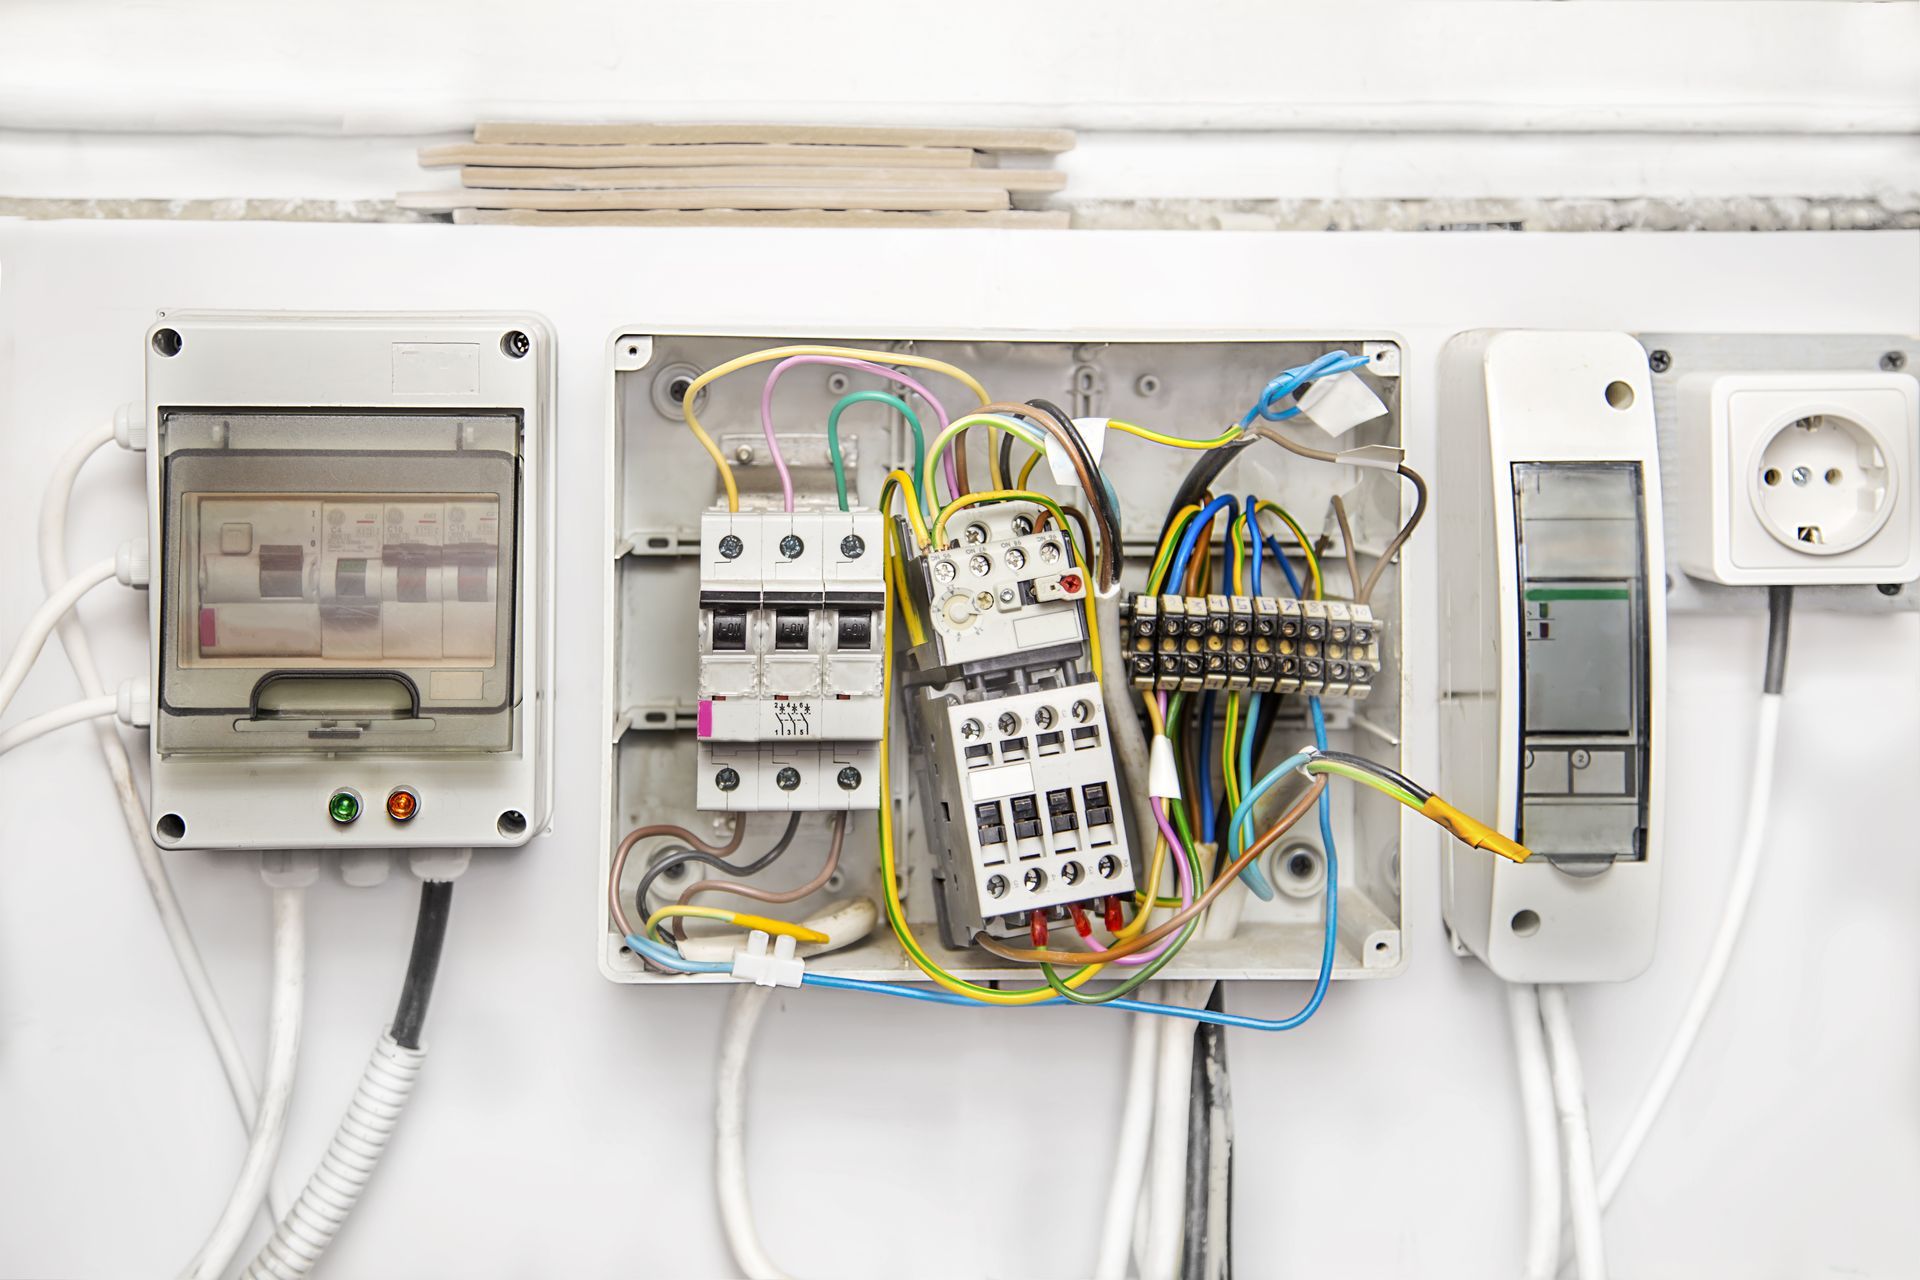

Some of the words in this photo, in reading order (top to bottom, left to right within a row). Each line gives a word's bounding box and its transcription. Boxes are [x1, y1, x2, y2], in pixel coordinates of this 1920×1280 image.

[1210, 597, 1224, 608] 4
[1235, 598, 1248, 610] 5
[1284, 599, 1295, 612] 7
